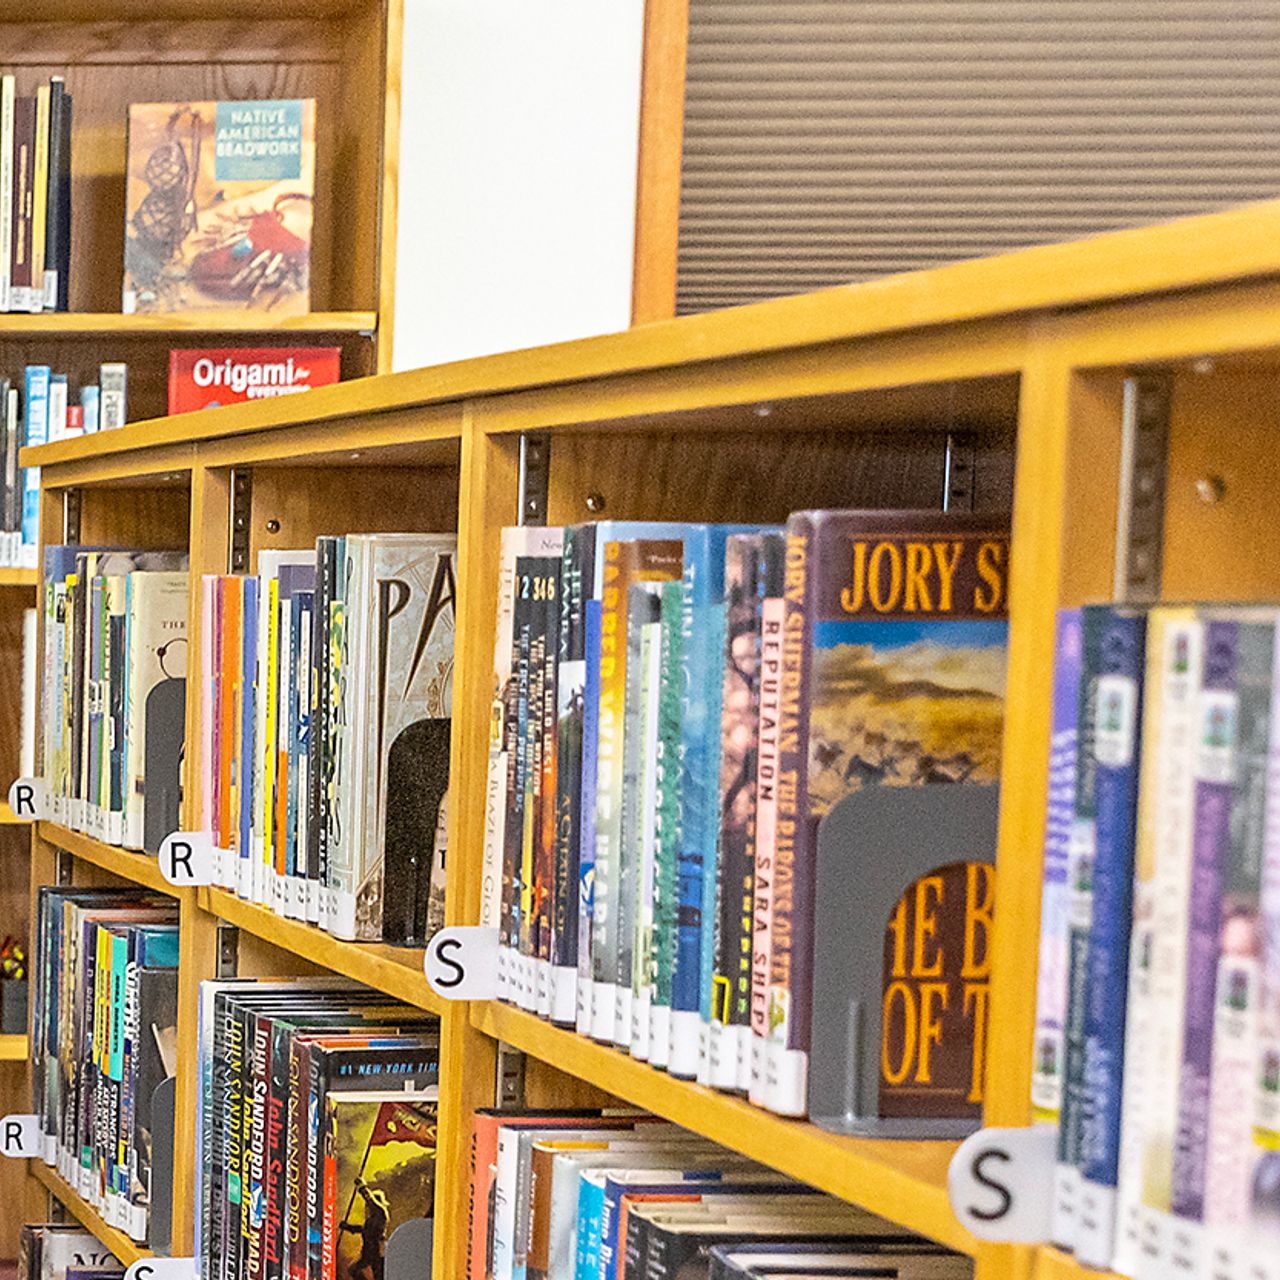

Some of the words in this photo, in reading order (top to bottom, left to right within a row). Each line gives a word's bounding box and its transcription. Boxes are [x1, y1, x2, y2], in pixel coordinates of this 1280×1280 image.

[218, 124, 299, 141] AMERICAN
[231, 109, 286, 125] NATIVE
[216, 140, 300, 159] BEADWORK
[192, 358, 294, 393] Origami
[784, 535, 807, 606] JORY
[841, 539, 960, 613] JORY
[600, 540, 621, 680] BARBED
[543, 654, 554, 695] THE
[777, 611, 803, 755] SHERMAN
[543, 696, 554, 728] WILD
[759, 621, 780, 803] REPUTATION
[543, 738, 554, 775] WEST
[595, 692, 617, 820] WIRE
[16, 786, 36, 815] R
[774, 771, 796, 816] THE
[170, 842, 194, 878] R
[593, 833, 612, 946] HEART
[754, 856, 771, 936] SARA
[433, 939, 465, 988] S
[252, 1029, 268, 1076] JOHN
[881, 983, 948, 1087] OF
[288, 1054, 301, 1106] JOHN
[340, 1061, 354, 1075] #1
[357, 1061, 380, 1075] NEW
[382, 1060, 415, 1075] YORK
[3, 1123, 24, 1151] R
[109, 1084, 119, 1160] STRANGERS
[252, 1081, 268, 1179] SANDFORD
[267, 1096, 284, 1142] John
[288, 1110, 301, 1243] SANDFORD
[968, 1148, 1012, 1221] S
[267, 1158, 284, 1265] Sandford
